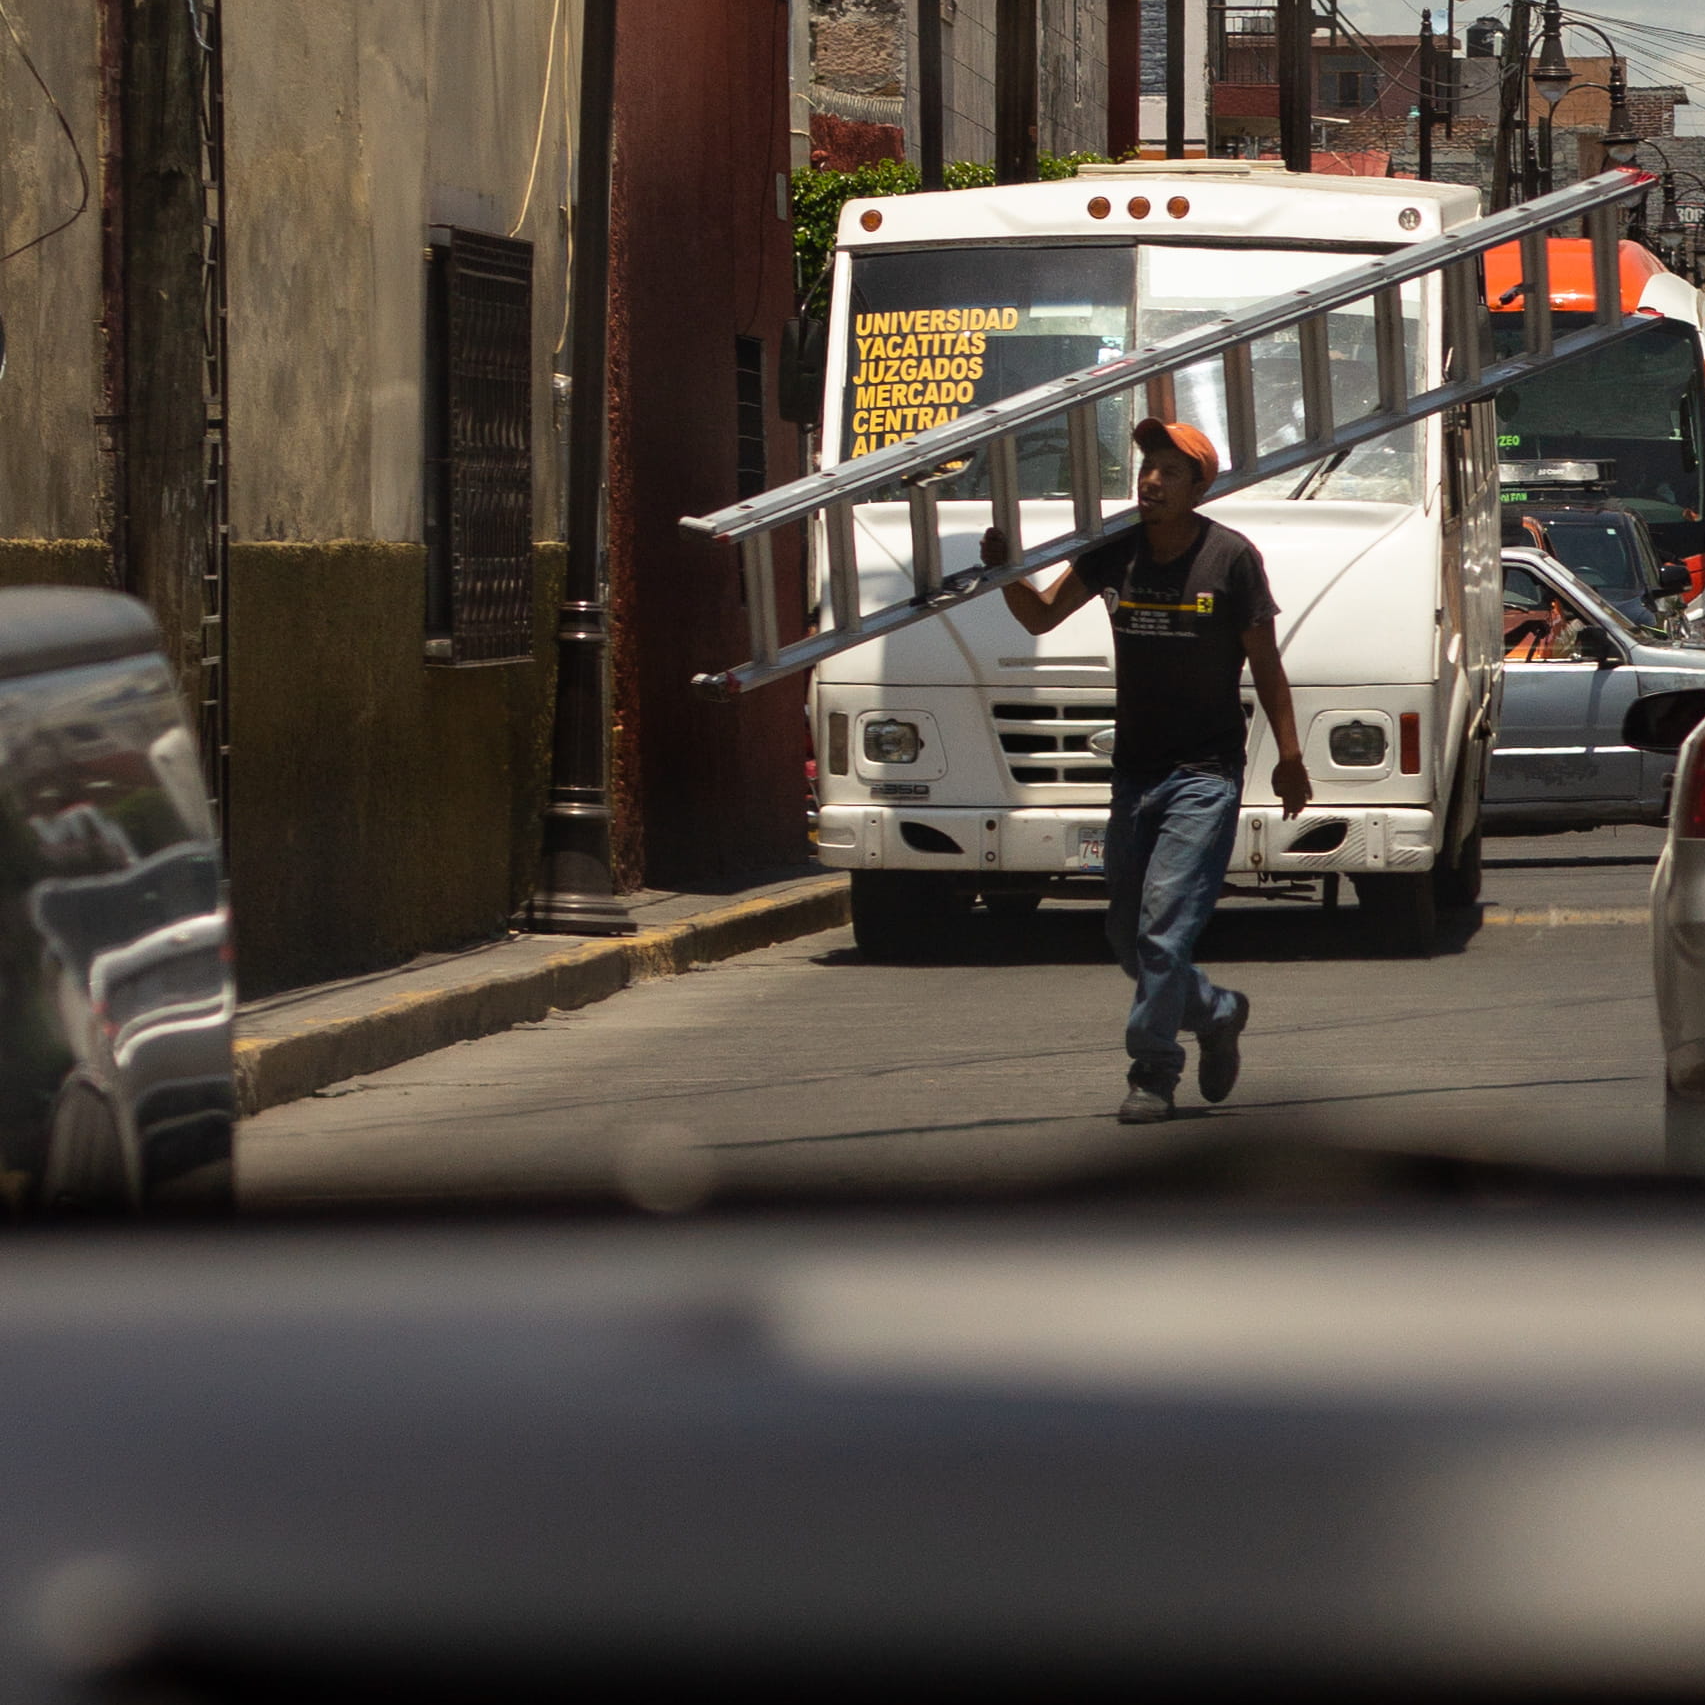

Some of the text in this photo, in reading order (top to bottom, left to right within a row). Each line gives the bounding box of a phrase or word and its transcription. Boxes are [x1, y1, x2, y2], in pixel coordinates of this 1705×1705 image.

[855, 307, 1018, 336] UNIVERSIDAD
[856, 332, 987, 360] YACATITAS
[852, 357, 984, 385] JUZGADOS
[855, 381, 974, 409] MERCADO
[1496, 435, 1520, 447] ZEO
